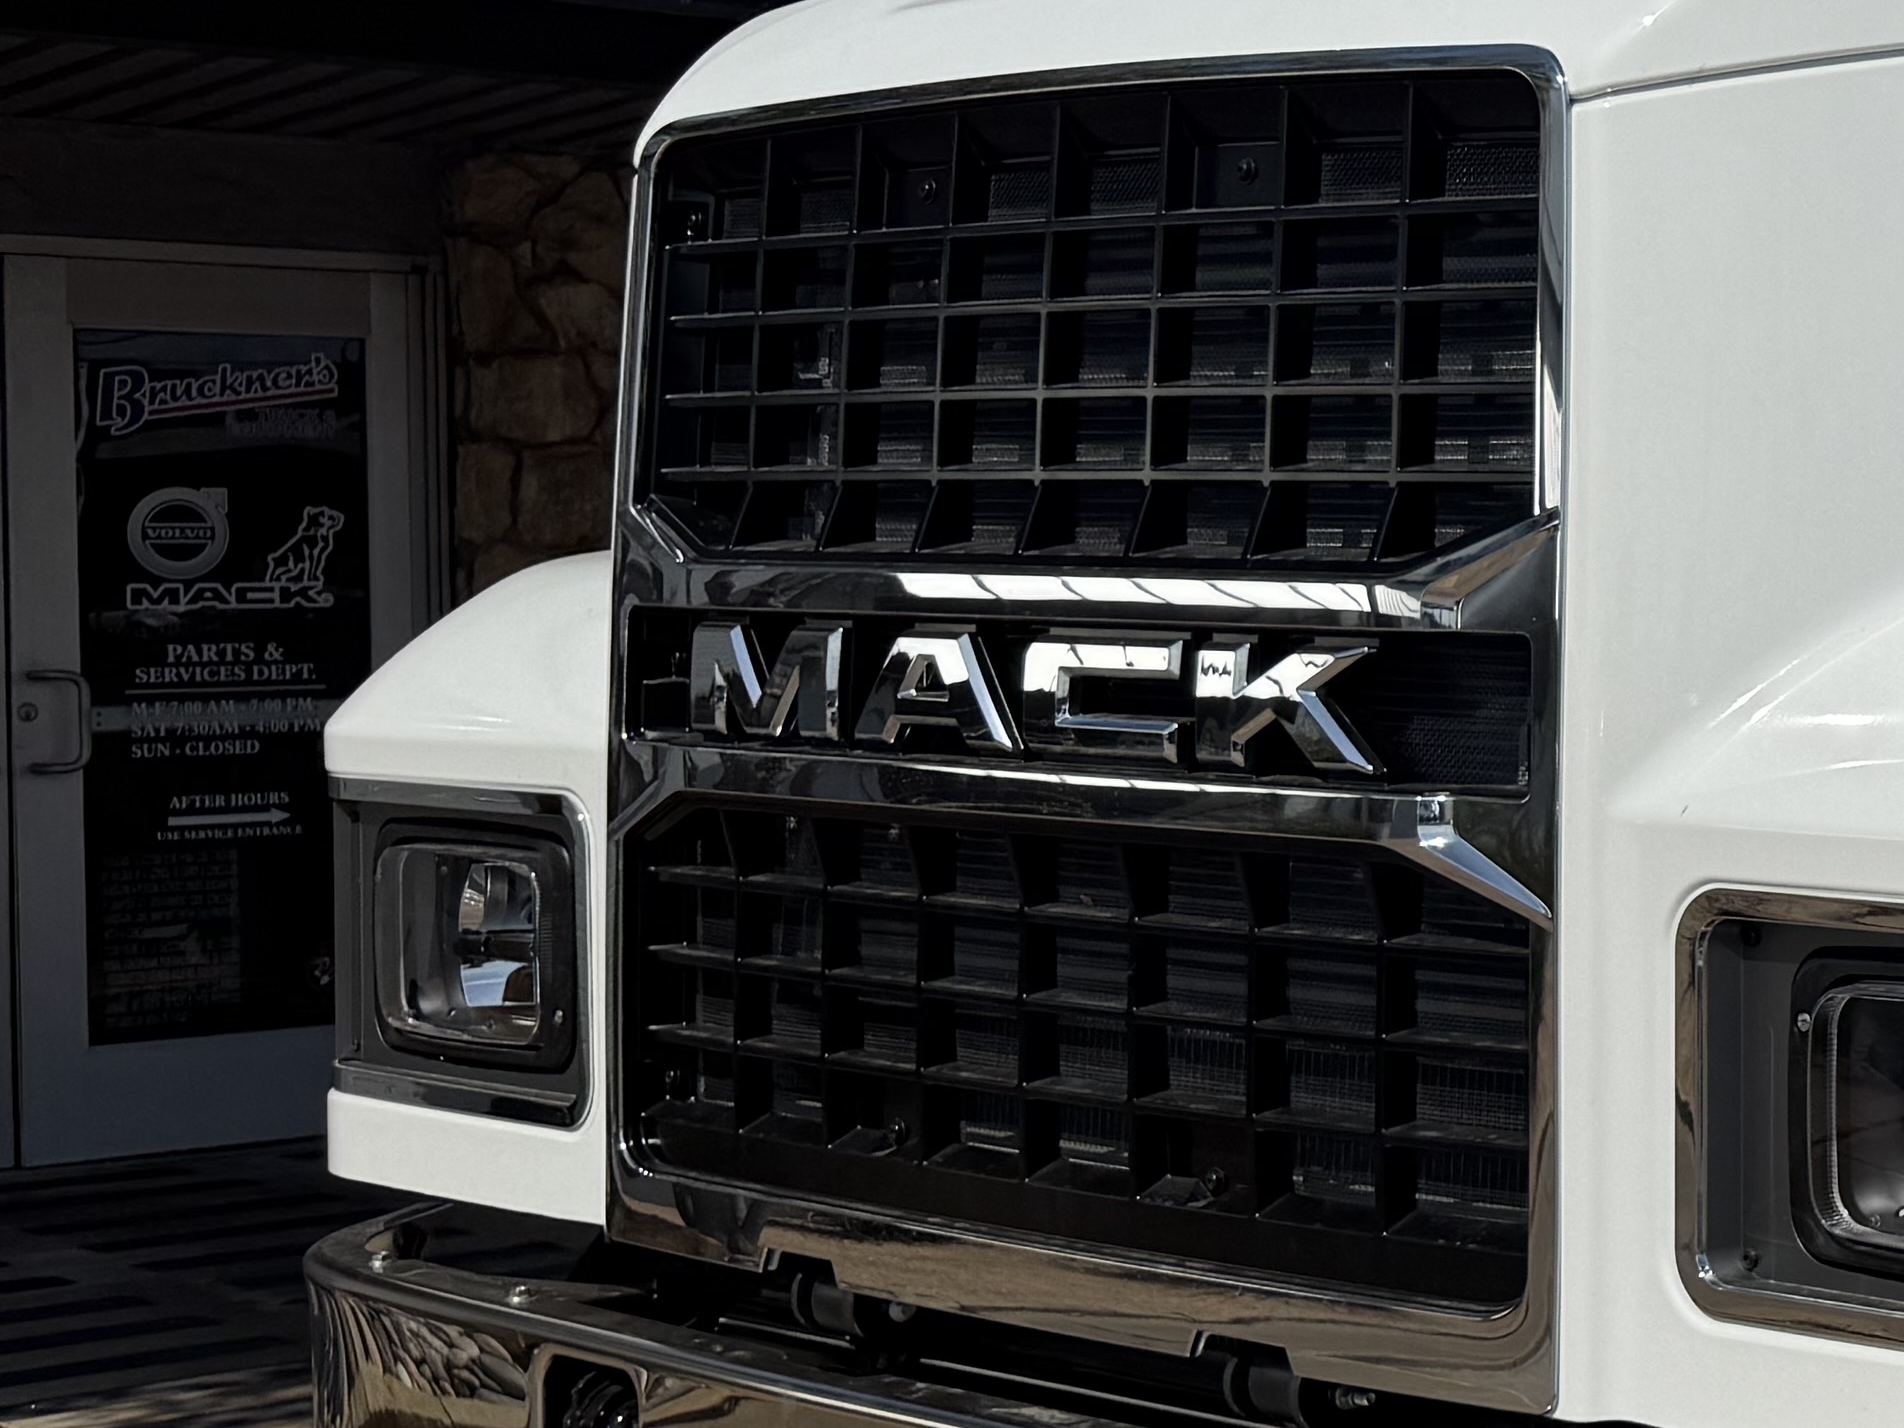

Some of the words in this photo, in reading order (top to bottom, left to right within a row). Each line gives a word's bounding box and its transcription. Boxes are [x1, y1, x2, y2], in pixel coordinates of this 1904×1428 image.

[96, 352, 338, 436] Bruckner's
[145, 526, 213, 539] VOLVO
[127, 583, 323, 609] MACK
[166, 643, 255, 663] PARTS
[263, 642, 285, 661] &
[135, 665, 246, 684] SERVICES
[252, 663, 317, 681] DEPT.
[691, 618, 1388, 778] MACK
[131, 723, 168, 739] SAT
[292, 718, 321, 733] PM
[131, 742, 170, 759] SUN
[184, 739, 261, 757] CLOSED
[169, 793, 226, 810] AFTER
[230, 790, 290, 808] HOURS
